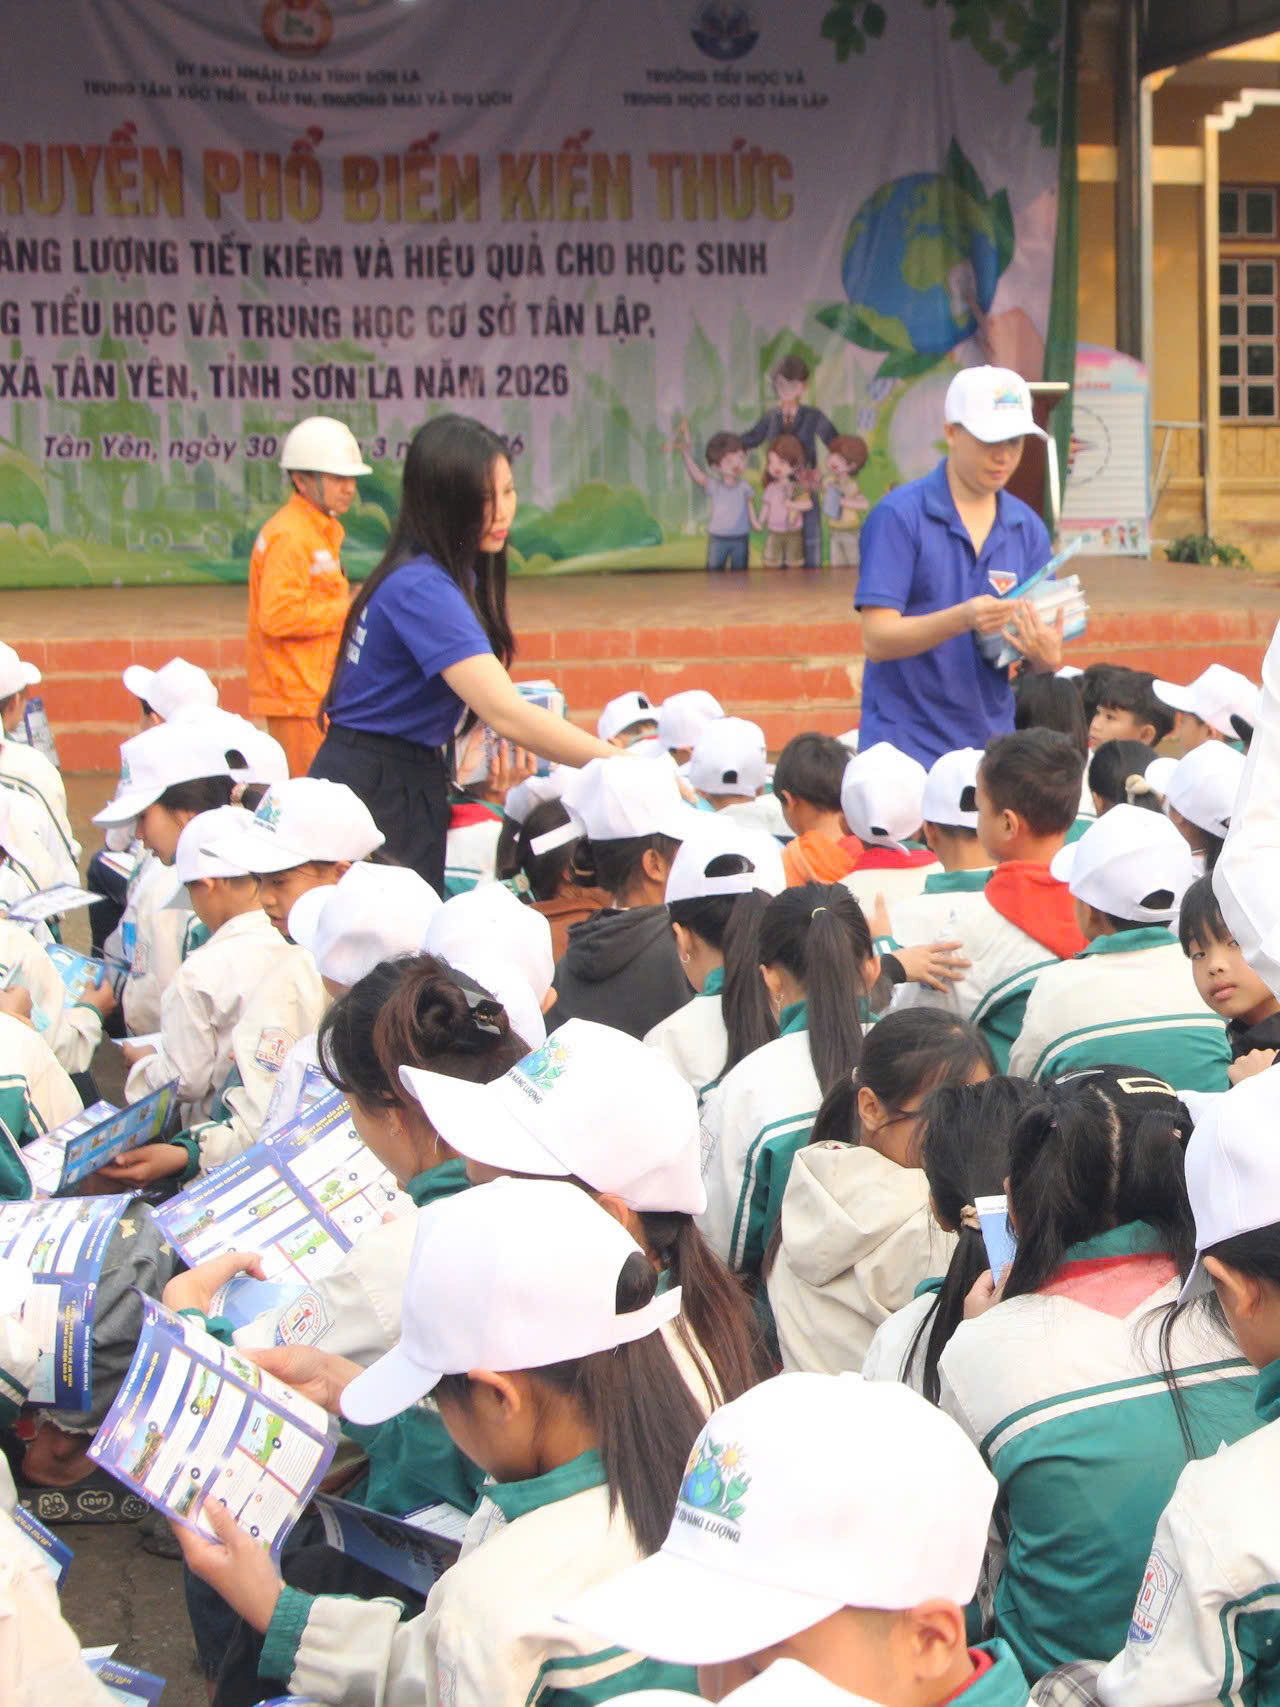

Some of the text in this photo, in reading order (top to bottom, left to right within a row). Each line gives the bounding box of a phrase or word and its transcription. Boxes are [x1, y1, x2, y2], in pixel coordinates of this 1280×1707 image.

[202, 125, 324, 223] PHỔ
[342, 130, 481, 224] BIẾN
[499, 128, 633, 223] KIẾN
[647, 137, 796, 222] THỨC
[72, 236, 179, 283] LƯỢNG
[190, 230, 252, 276] TIẾT
[263, 235, 343, 286] KIỆM
[353, 237, 394, 280] VÀ
[404, 237, 475, 286] HIỆU
[486, 231, 545, 282] QUẢ
[556, 241, 615, 277] CHO
[626, 242, 685, 284] HỌC
[696, 242, 768, 277] SINH
[31, 286, 101, 336] TIỂU
[113, 301, 177, 345] HỌC
[187, 295, 229, 338] VÀ
[237, 303, 341, 339] TRUNG
[353, 303, 415, 348] HỌC
[426, 303, 467, 339] CƠ
[477, 291, 517, 339] SỞ
[526, 295, 584, 338] TÂN
[596, 294, 656, 345] LẬP,
[0, 351, 569, 402] XÃ TÂN YÊN, TỈNH SƠN LA NĂM 2026
[43, 435, 92, 459] Tân
[102, 436, 158, 462] Yên,
[168, 434, 237, 464] ngày
[245, 436, 279, 458] 30
[372, 436, 387, 459] 3
[83, 1497, 108, 1506] LOVE
